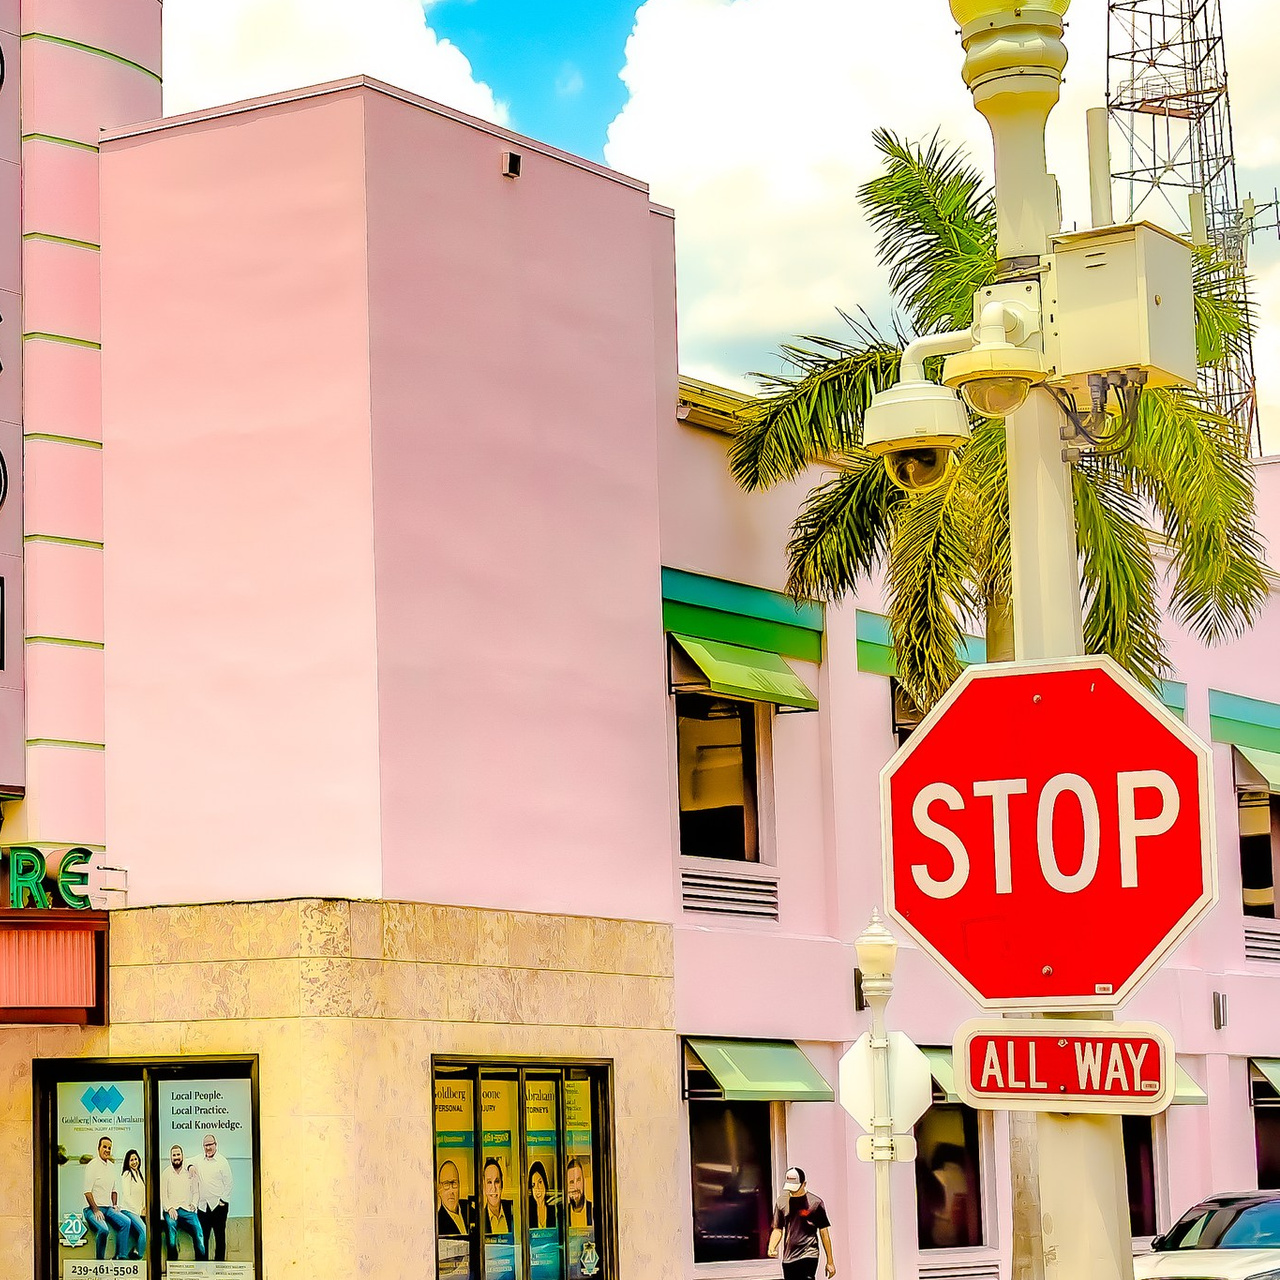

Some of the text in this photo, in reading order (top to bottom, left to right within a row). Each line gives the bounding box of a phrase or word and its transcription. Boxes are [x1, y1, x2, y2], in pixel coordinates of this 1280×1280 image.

[910, 769, 1181, 900] STOP
[980, 1040, 1150, 1092] ALL WAY
[171, 1091, 224, 1103] Local People.
[481, 1090, 501, 1099] oone
[171, 1106, 229, 1115] Local Practice.
[171, 1120, 243, 1131] Local Knowledge.
[64, 1219, 82, 1234] 20
[71, 1264, 139, 1276] 239-461-5508
